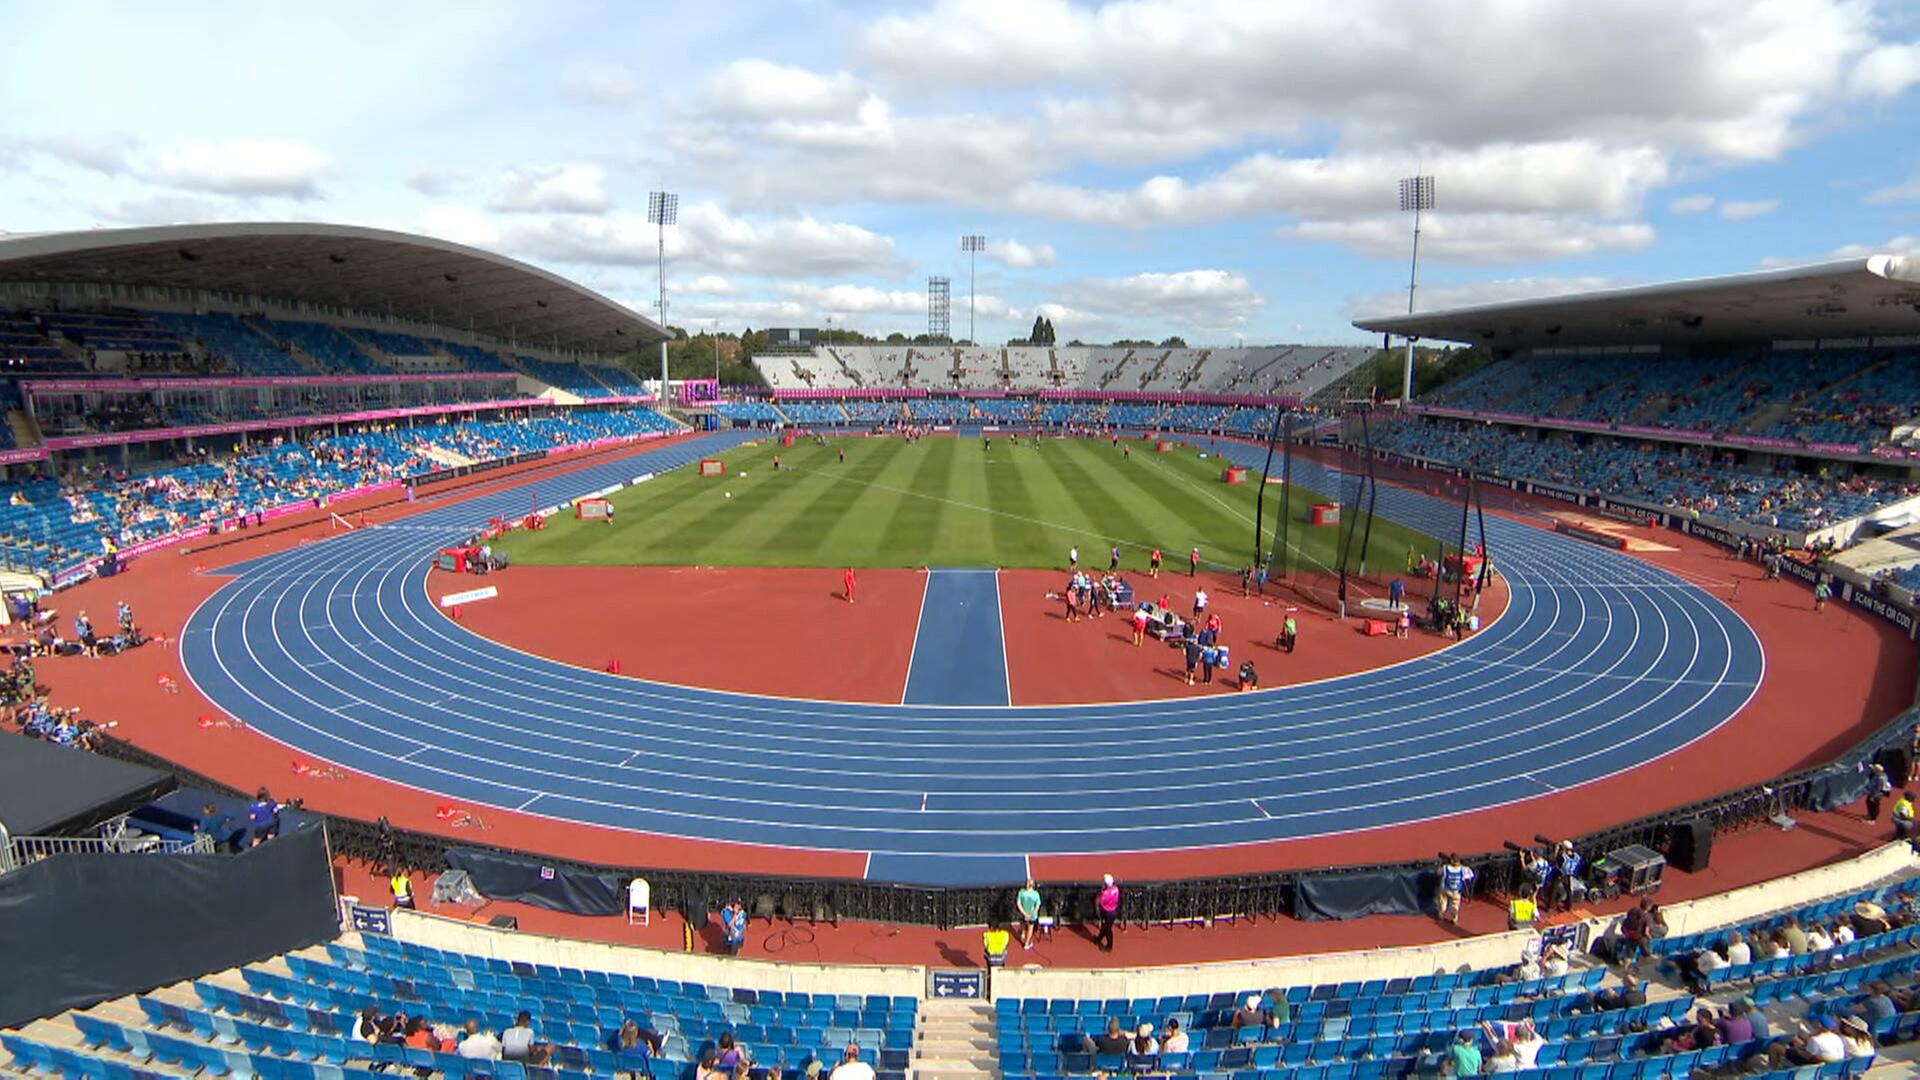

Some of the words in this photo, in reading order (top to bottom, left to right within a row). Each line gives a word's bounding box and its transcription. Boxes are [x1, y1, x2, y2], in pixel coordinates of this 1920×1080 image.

[1855, 591, 1873, 609] SCAN
[1873, 600, 1886, 616] THE
[1886, 606, 1897, 620] QR
